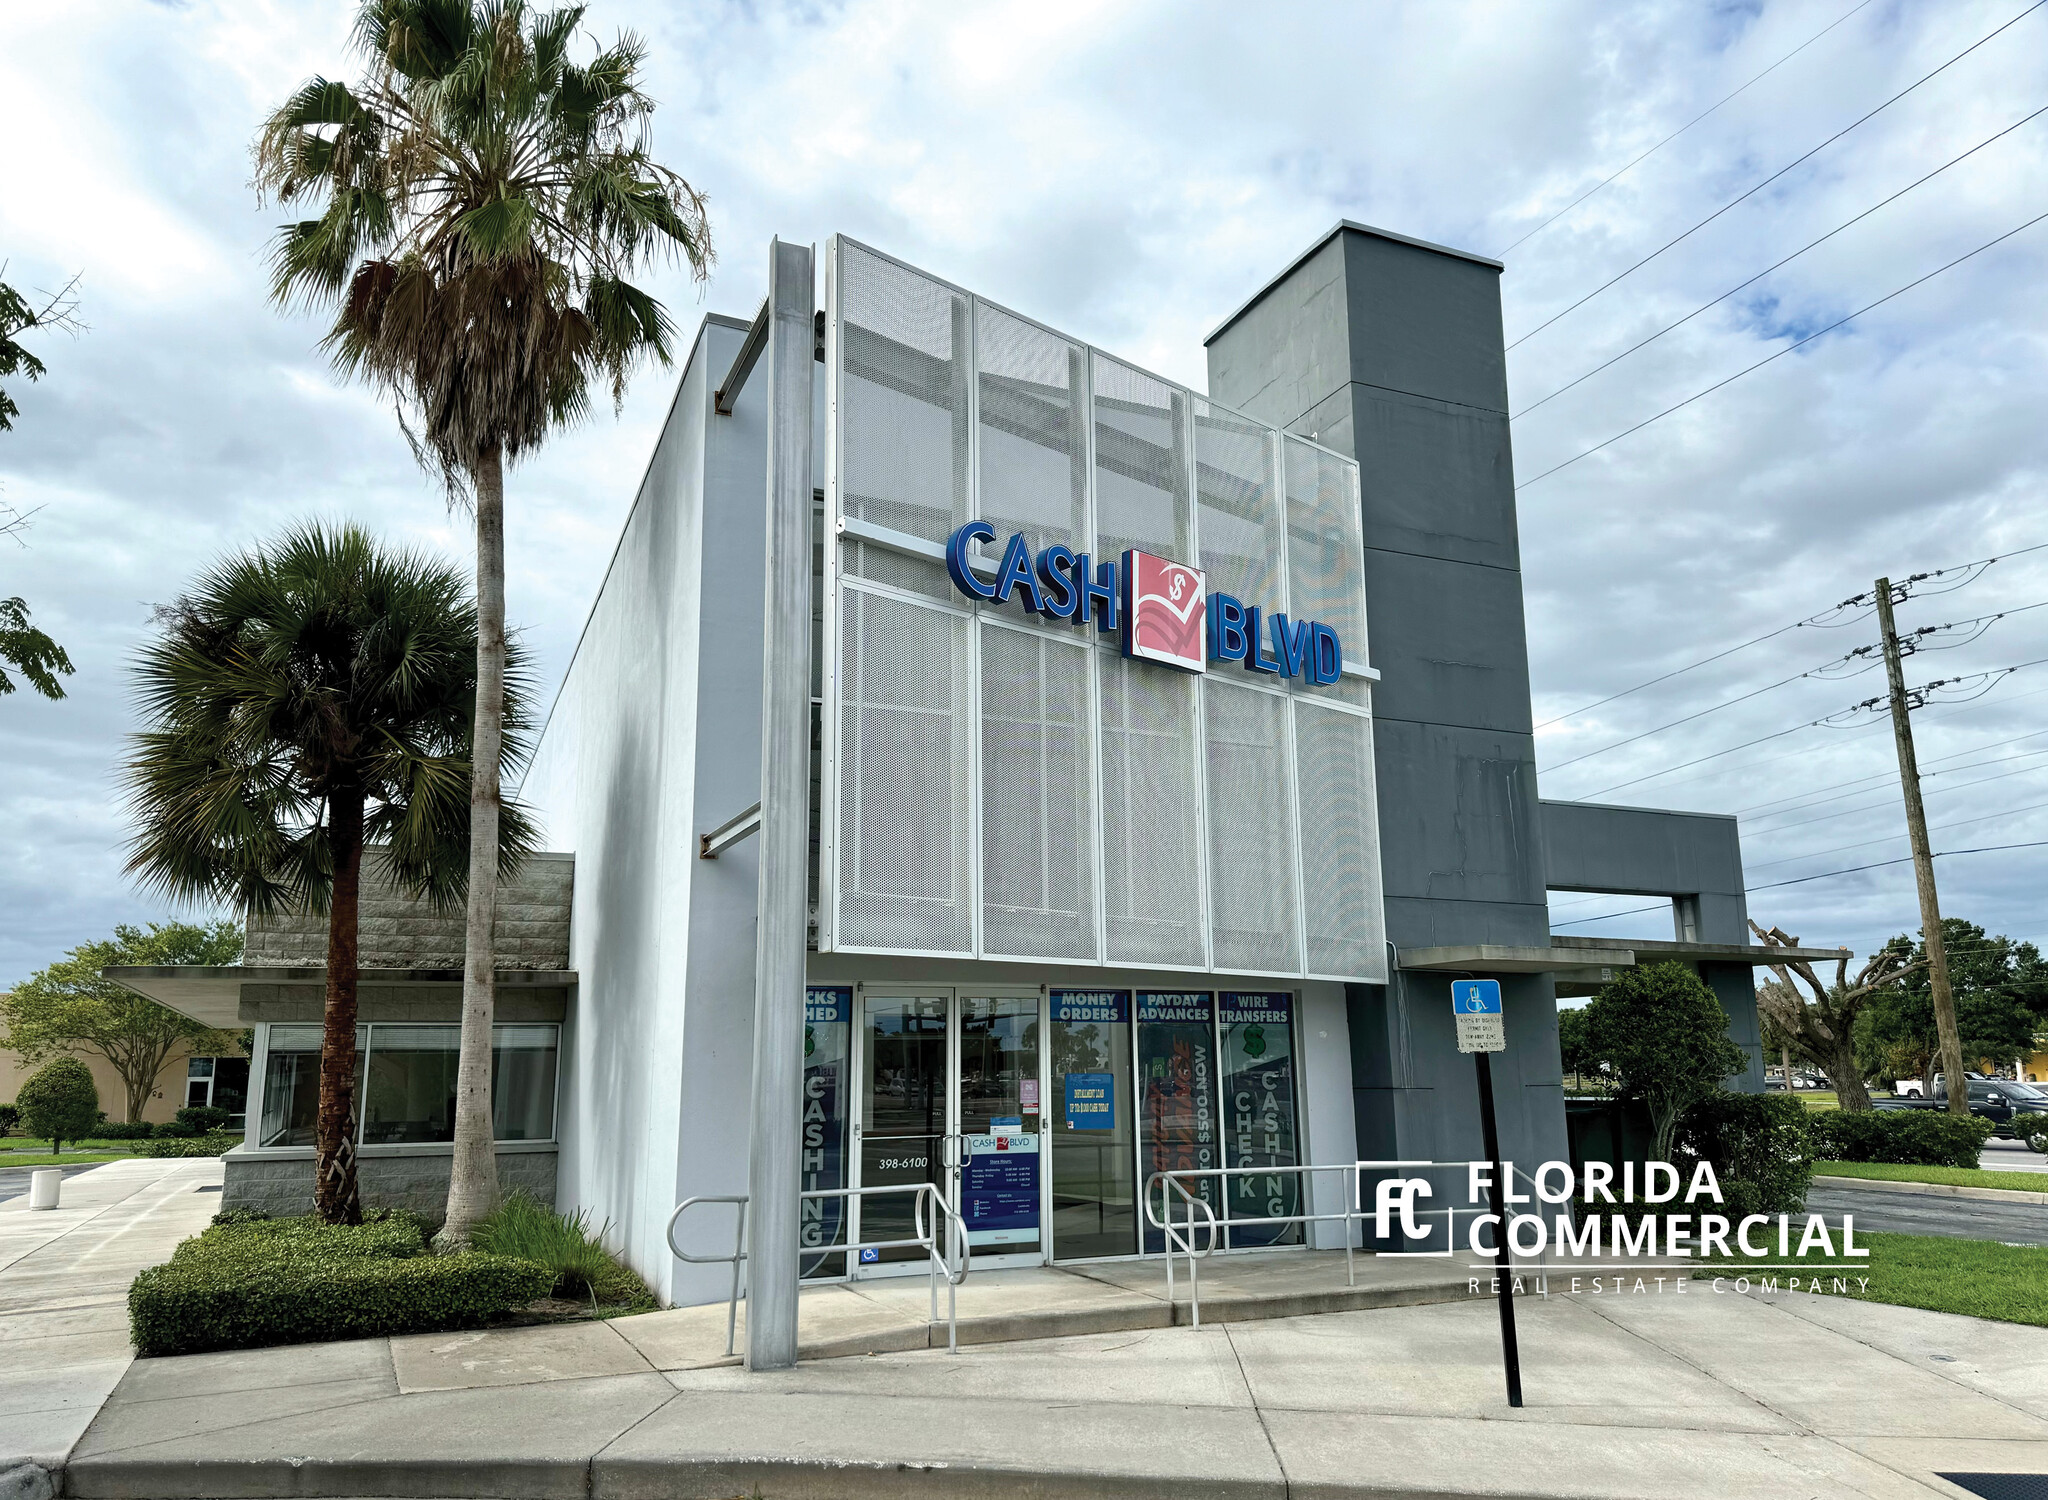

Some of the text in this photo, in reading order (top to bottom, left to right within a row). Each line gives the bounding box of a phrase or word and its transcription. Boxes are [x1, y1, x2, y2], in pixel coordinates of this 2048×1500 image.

[946, 520, 1342, 686] CASH BLVD
[1061, 992, 1115, 1006] MONEY
[1147, 994, 1199, 1007] PAYDAY
[1237, 996, 1268, 1008] WIRE
[1059, 1007, 1118, 1021] ORDERS
[1138, 1008, 1209, 1021] ADVANCES
[1219, 1010, 1288, 1023] TRANSFERS
[1194, 1044, 1208, 1090] NOW
[1196, 1095, 1211, 1143] $500
[972, 1138, 1030, 1147] CASH BLVD
[1235, 1091, 1256, 1198] CHECK
[1261, 1071, 1285, 1217] CASHING
[801, 1076, 827, 1246] CASHING
[879, 1157, 928, 1170] 398-6100
